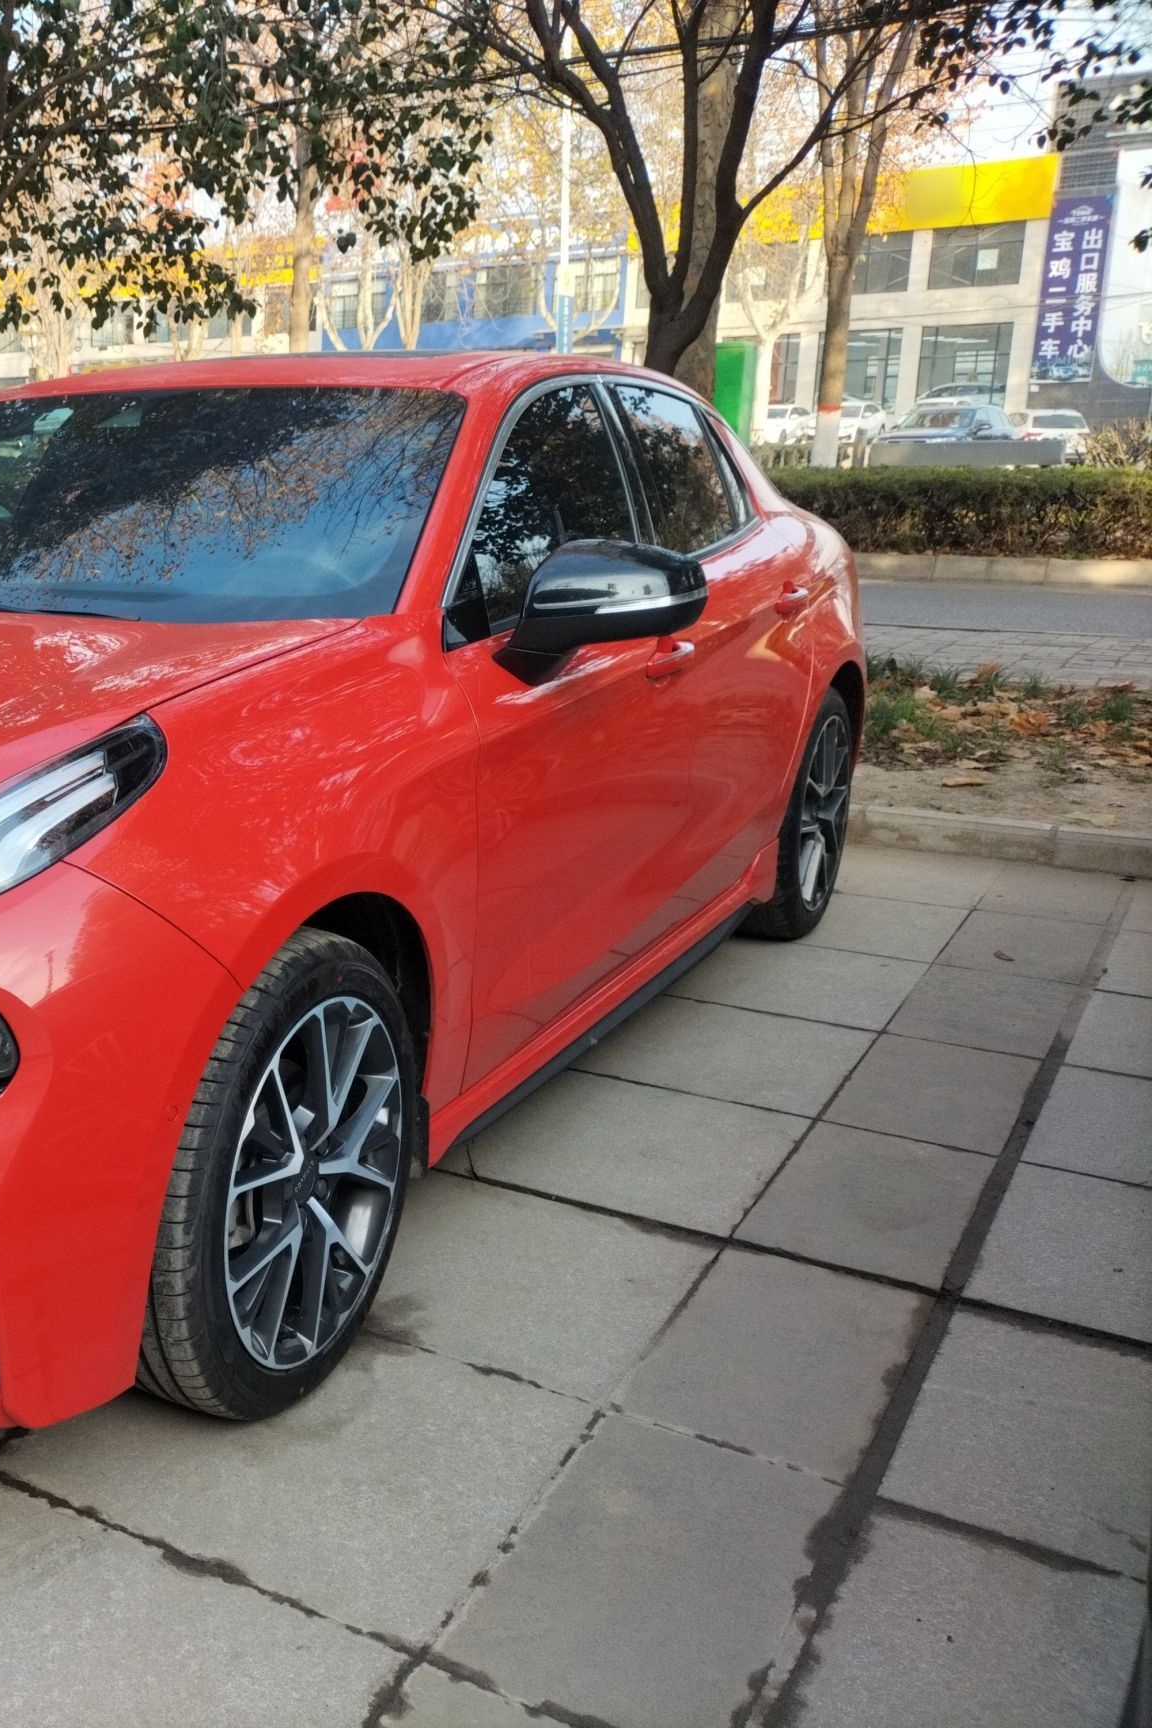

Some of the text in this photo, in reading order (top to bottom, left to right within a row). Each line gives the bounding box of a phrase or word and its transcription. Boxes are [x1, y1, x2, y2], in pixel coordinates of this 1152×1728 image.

[1038, 229, 1076, 360] 宝鸡二手车
[1066, 227, 1104, 360] 出口服务中心
